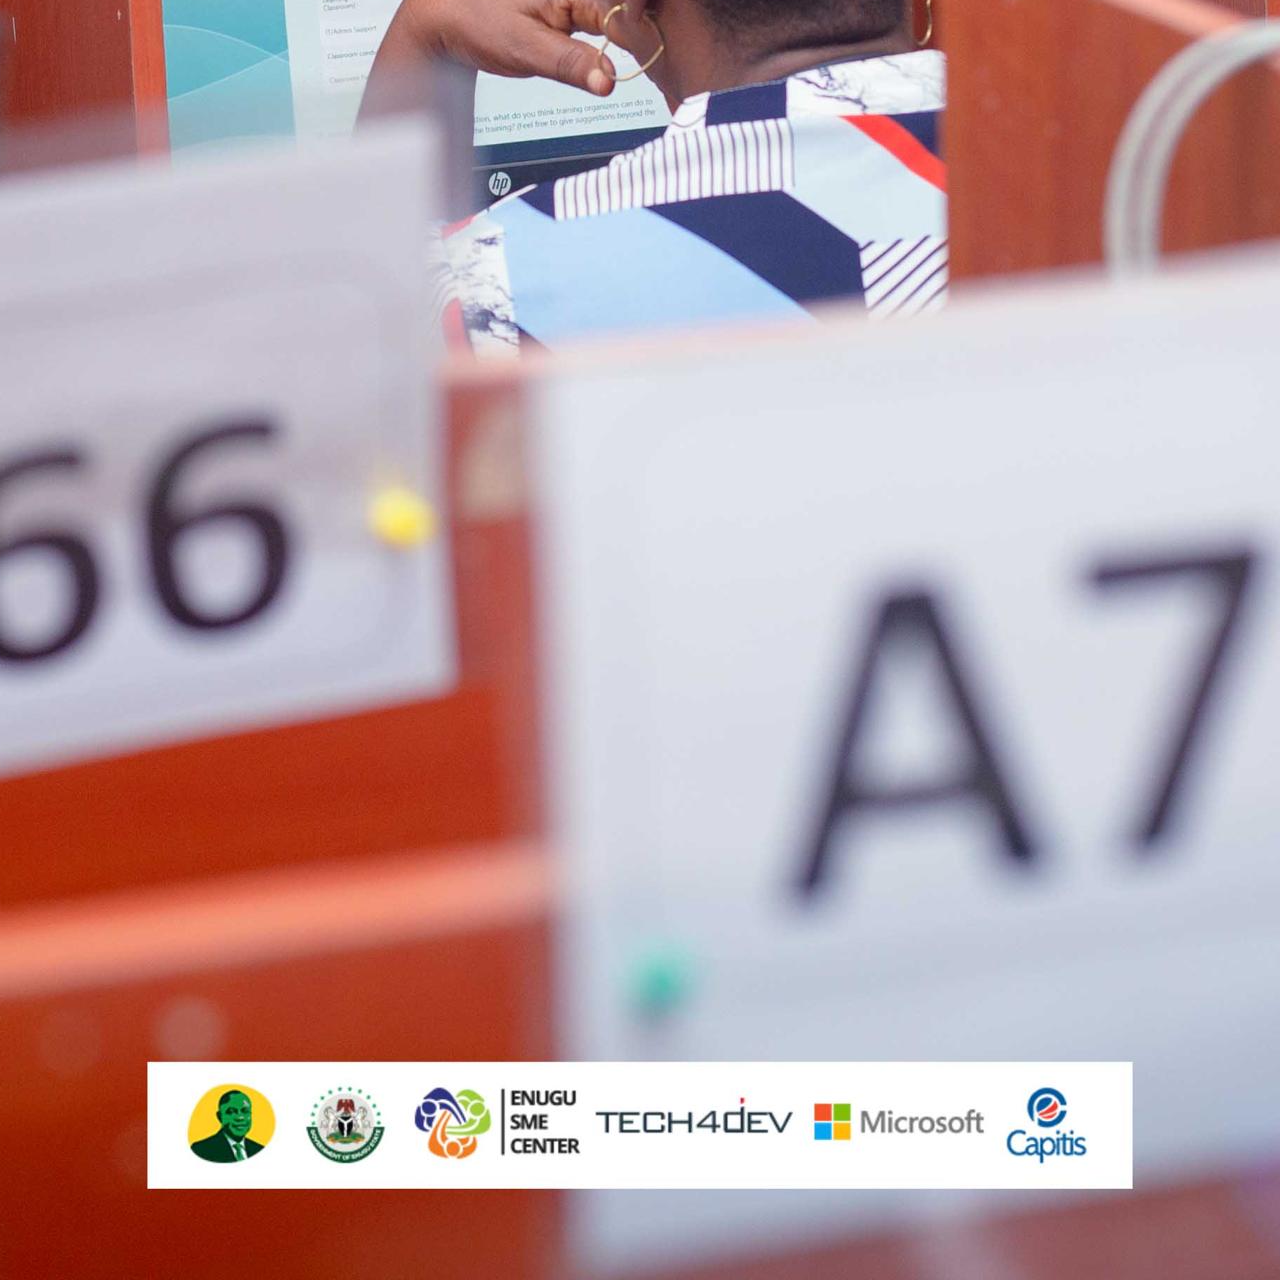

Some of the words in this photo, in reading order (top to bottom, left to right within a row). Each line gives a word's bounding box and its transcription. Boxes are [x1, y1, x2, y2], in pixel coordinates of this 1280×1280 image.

[485, 122, 515, 134] training?
[534, 118, 548, 128] free
[549, 118, 558, 126] to
[559, 116, 574, 127] give
[575, 112, 616, 125] suggestions
[617, 109, 643, 122] beyond
[644, 108, 656, 117] the
[493, 111, 510, 121] what
[511, 110, 522, 119] do
[523, 111, 536, 121] you
[537, 107, 554, 117] think
[556, 105, 583, 117] training
[584, 102, 620, 114] organizers
[620, 101, 634, 109] can
[634, 98, 644, 107] do
[645, 98, 653, 106] to
[490, 172, 510, 195] hp
